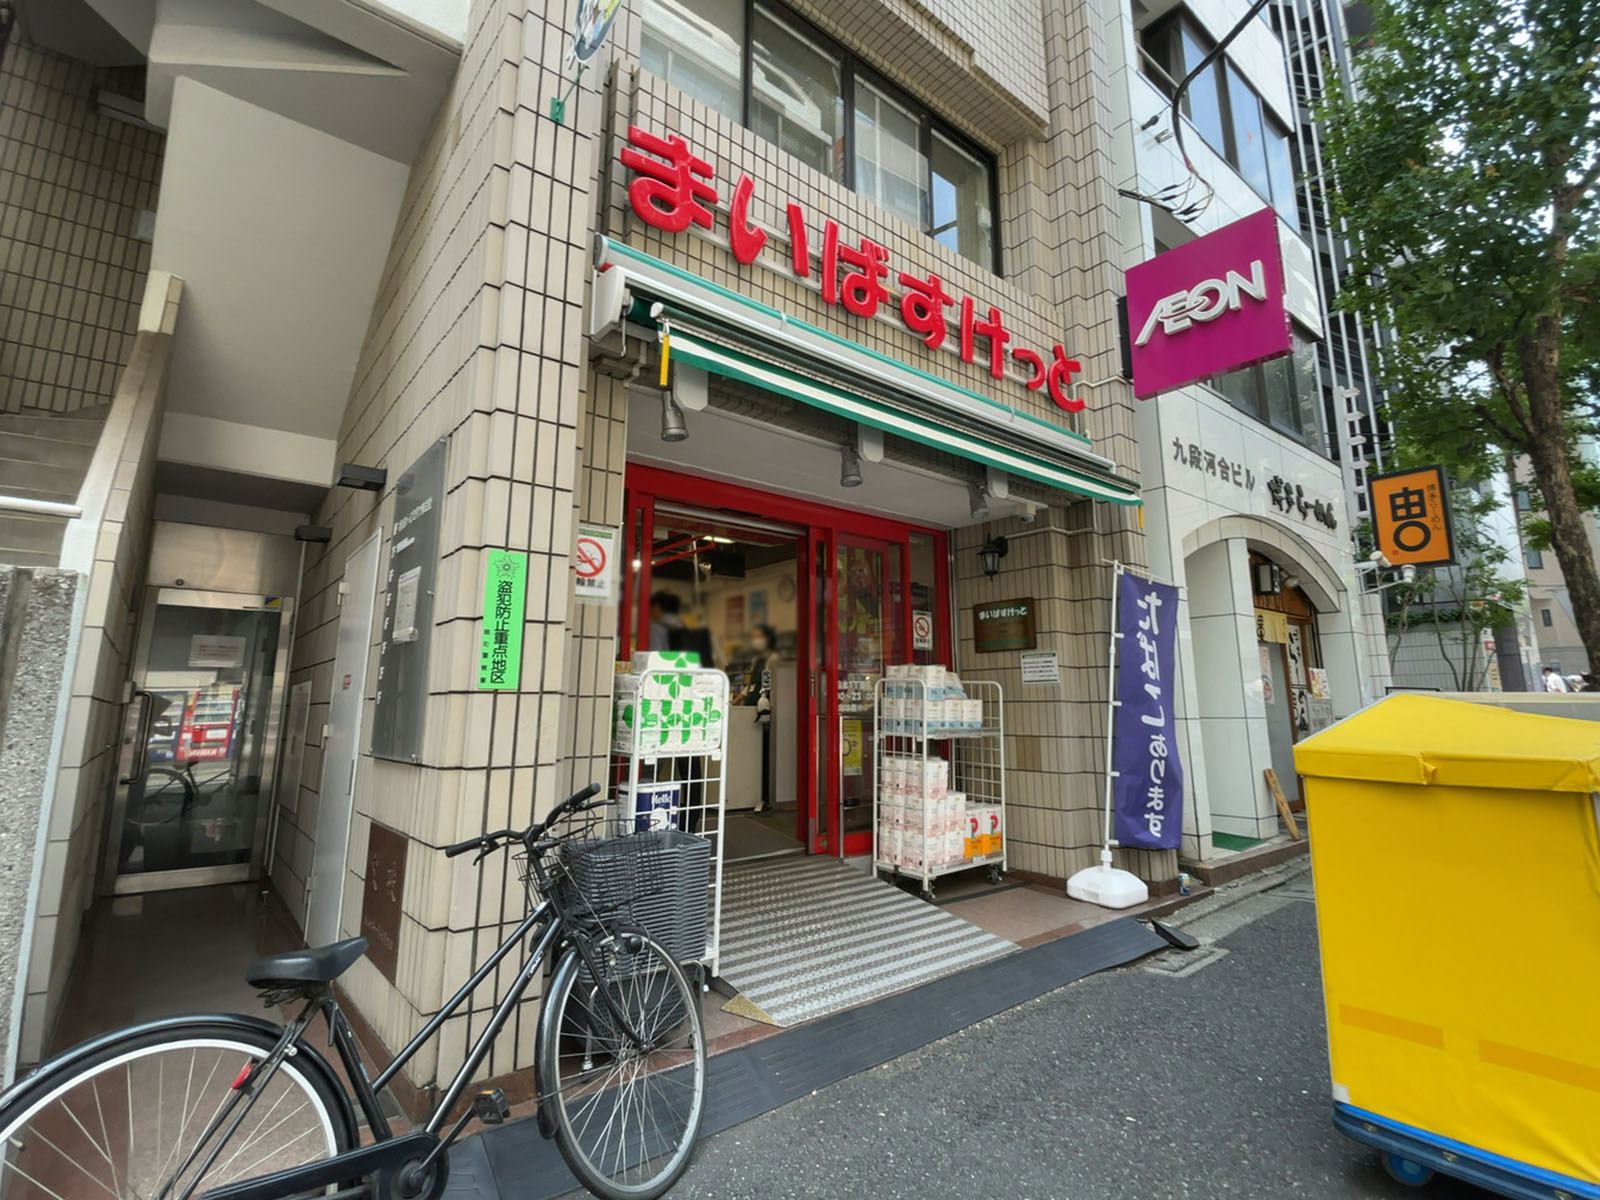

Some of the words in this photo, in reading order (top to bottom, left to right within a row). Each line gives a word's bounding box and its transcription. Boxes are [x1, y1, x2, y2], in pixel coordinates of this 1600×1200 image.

[621, 125, 1086, 413] まいばすけっと
[1172, 436, 1255, 492] 九段河合ビル
[490, 580, 513, 684] 盗犯防止重点地区
